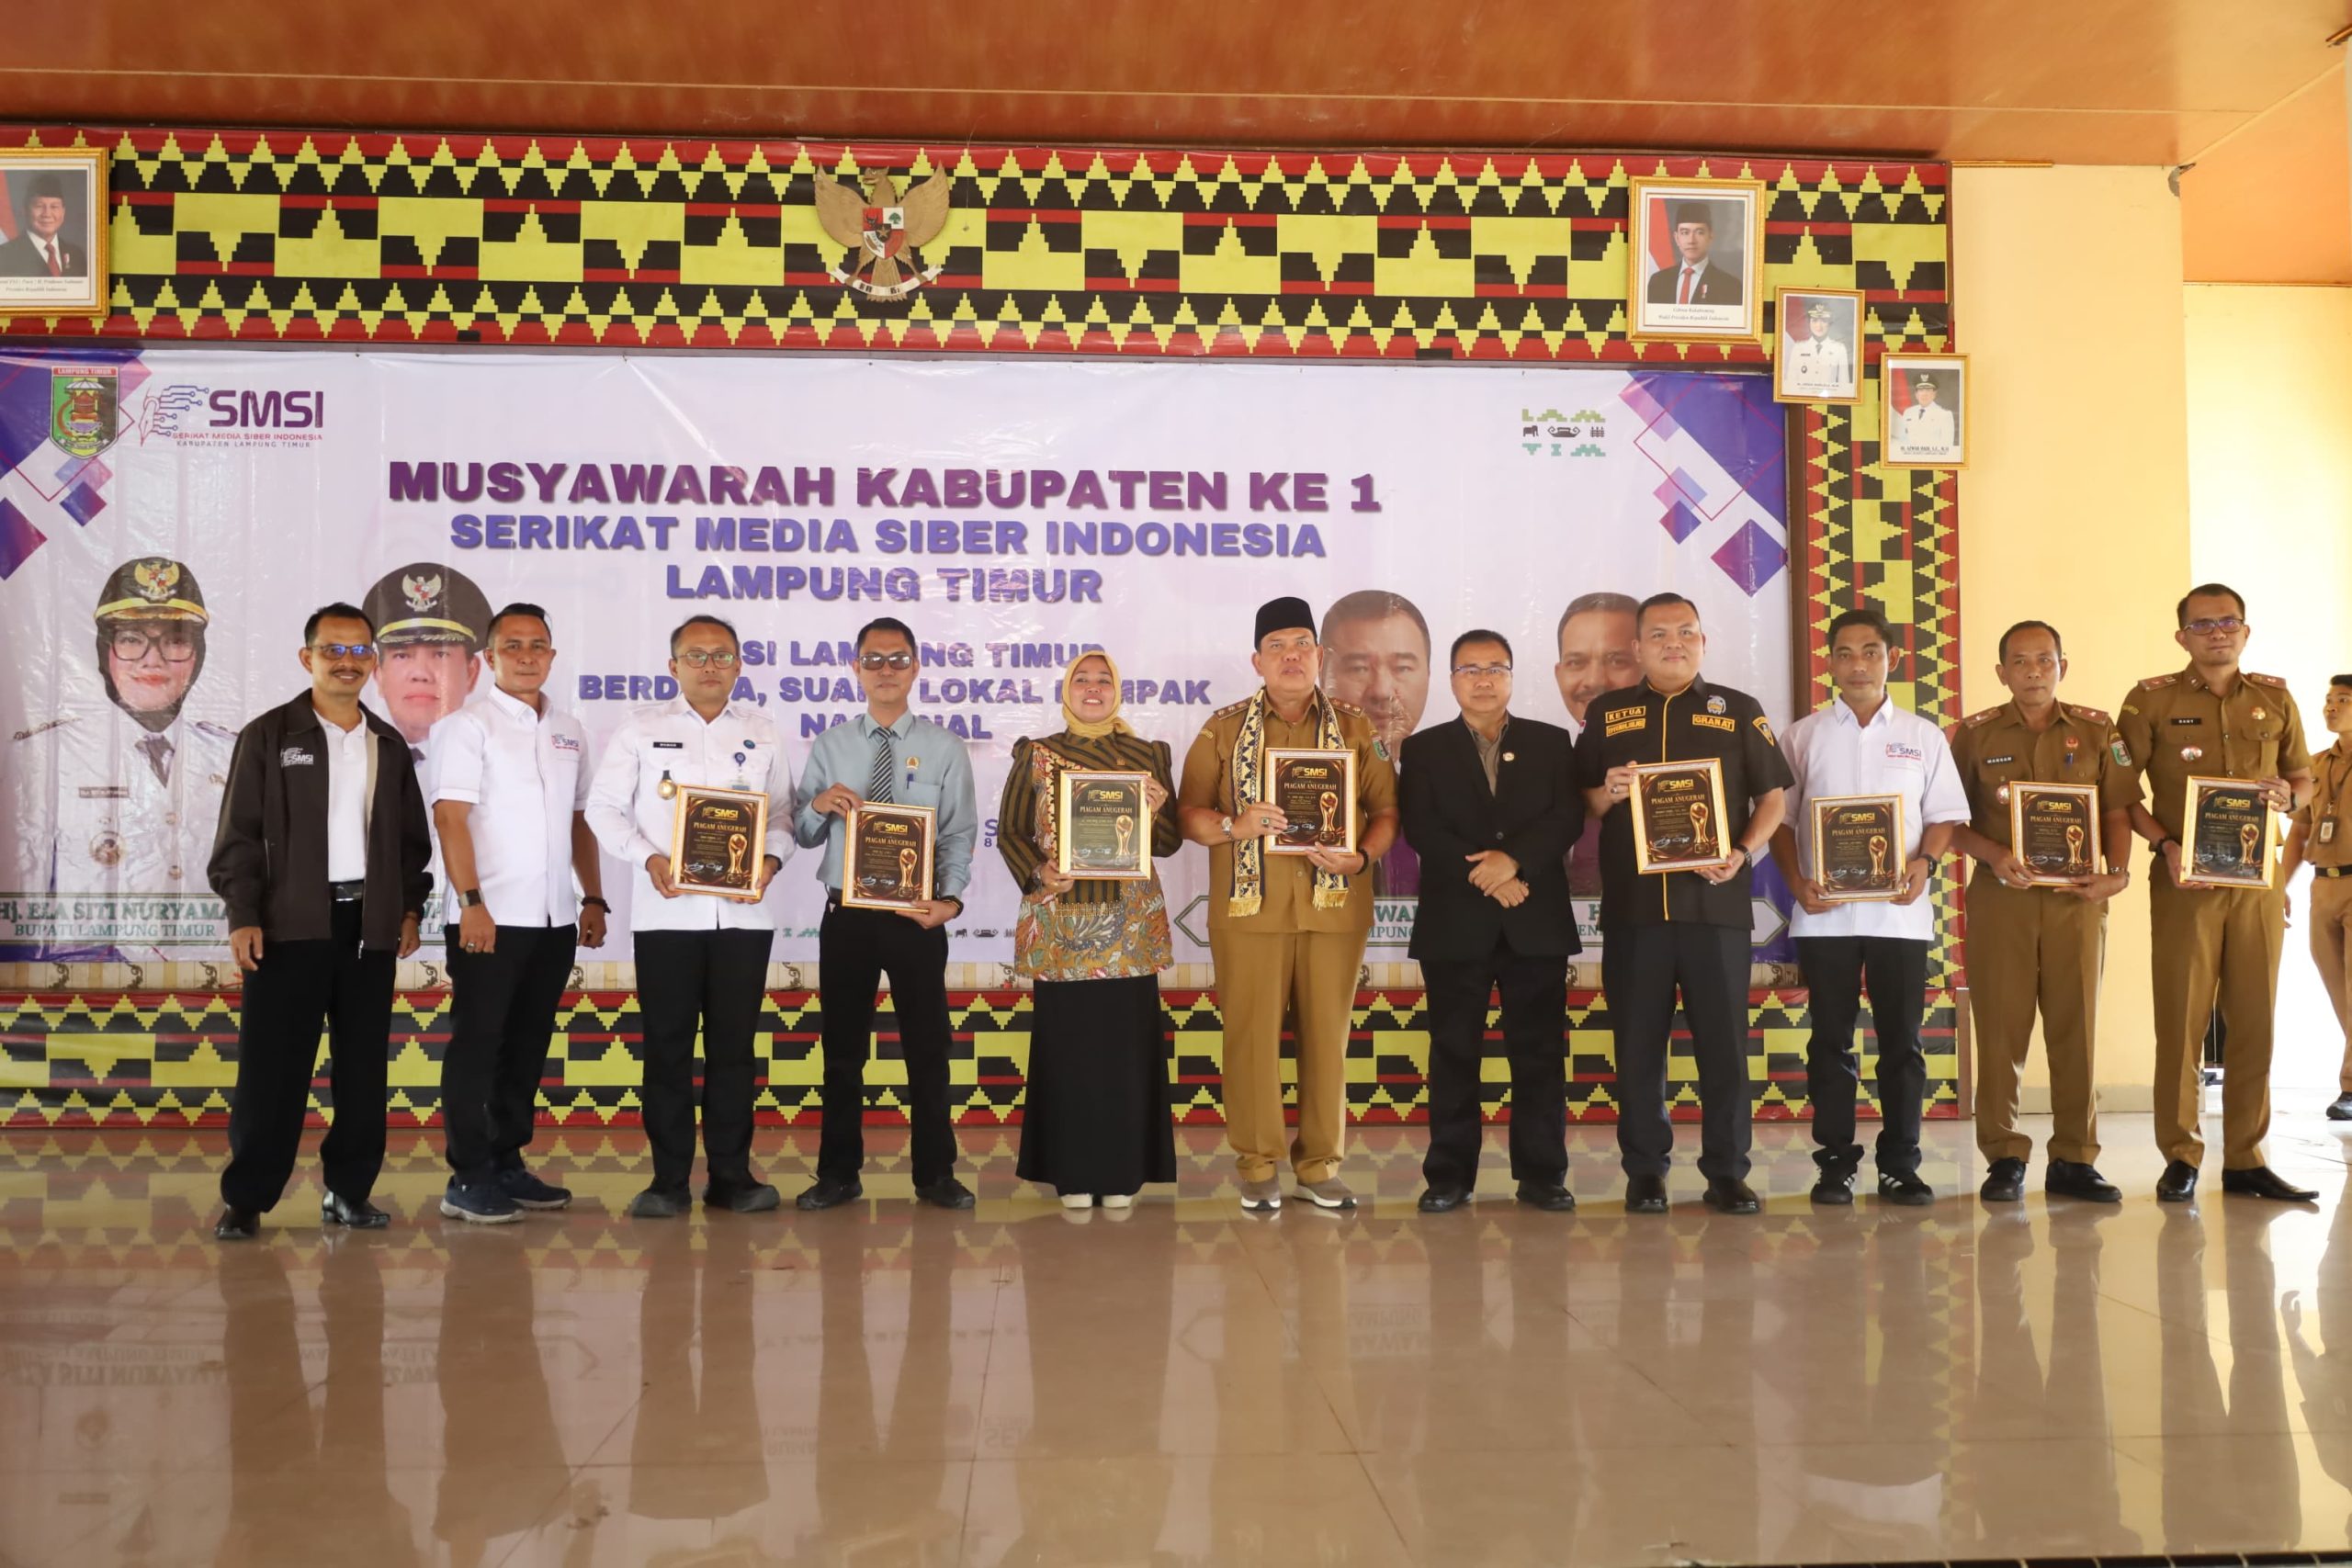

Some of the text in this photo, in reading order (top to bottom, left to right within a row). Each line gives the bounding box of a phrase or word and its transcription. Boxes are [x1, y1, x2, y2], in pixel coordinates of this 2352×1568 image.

[209, 389, 323, 428] SMSI
[173, 432, 209, 440] SERIKAT
[274, 433, 322, 441] INDONESIA
[390, 461, 1381, 512] MUSYAWARAH KABUPATEN KE 1
[450, 513, 1327, 558] SERIKAT MEDIA SIBER INDONESIA
[666, 565, 1102, 604] LAMPUNG TIMUR
[741, 640, 777, 665] SI
[919, 678, 1043, 704] LOKAL
[1609, 708, 1642, 721] KETUA
[1304, 768, 1327, 777] SMSI
[1669, 779, 1693, 789] SMSI
[1100, 791, 1123, 800] SMSI
[2048, 802, 2072, 810] SMSI
[2226, 798, 2250, 808] SMSI
[715, 808, 739, 818] SMSI
[1851, 813, 1875, 822] SMSI
[885, 823, 908, 833] SMSI
[74, 902, 117, 919] SITI
[15, 924, 216, 937] BUPATI LAMPUNG TIMUR
